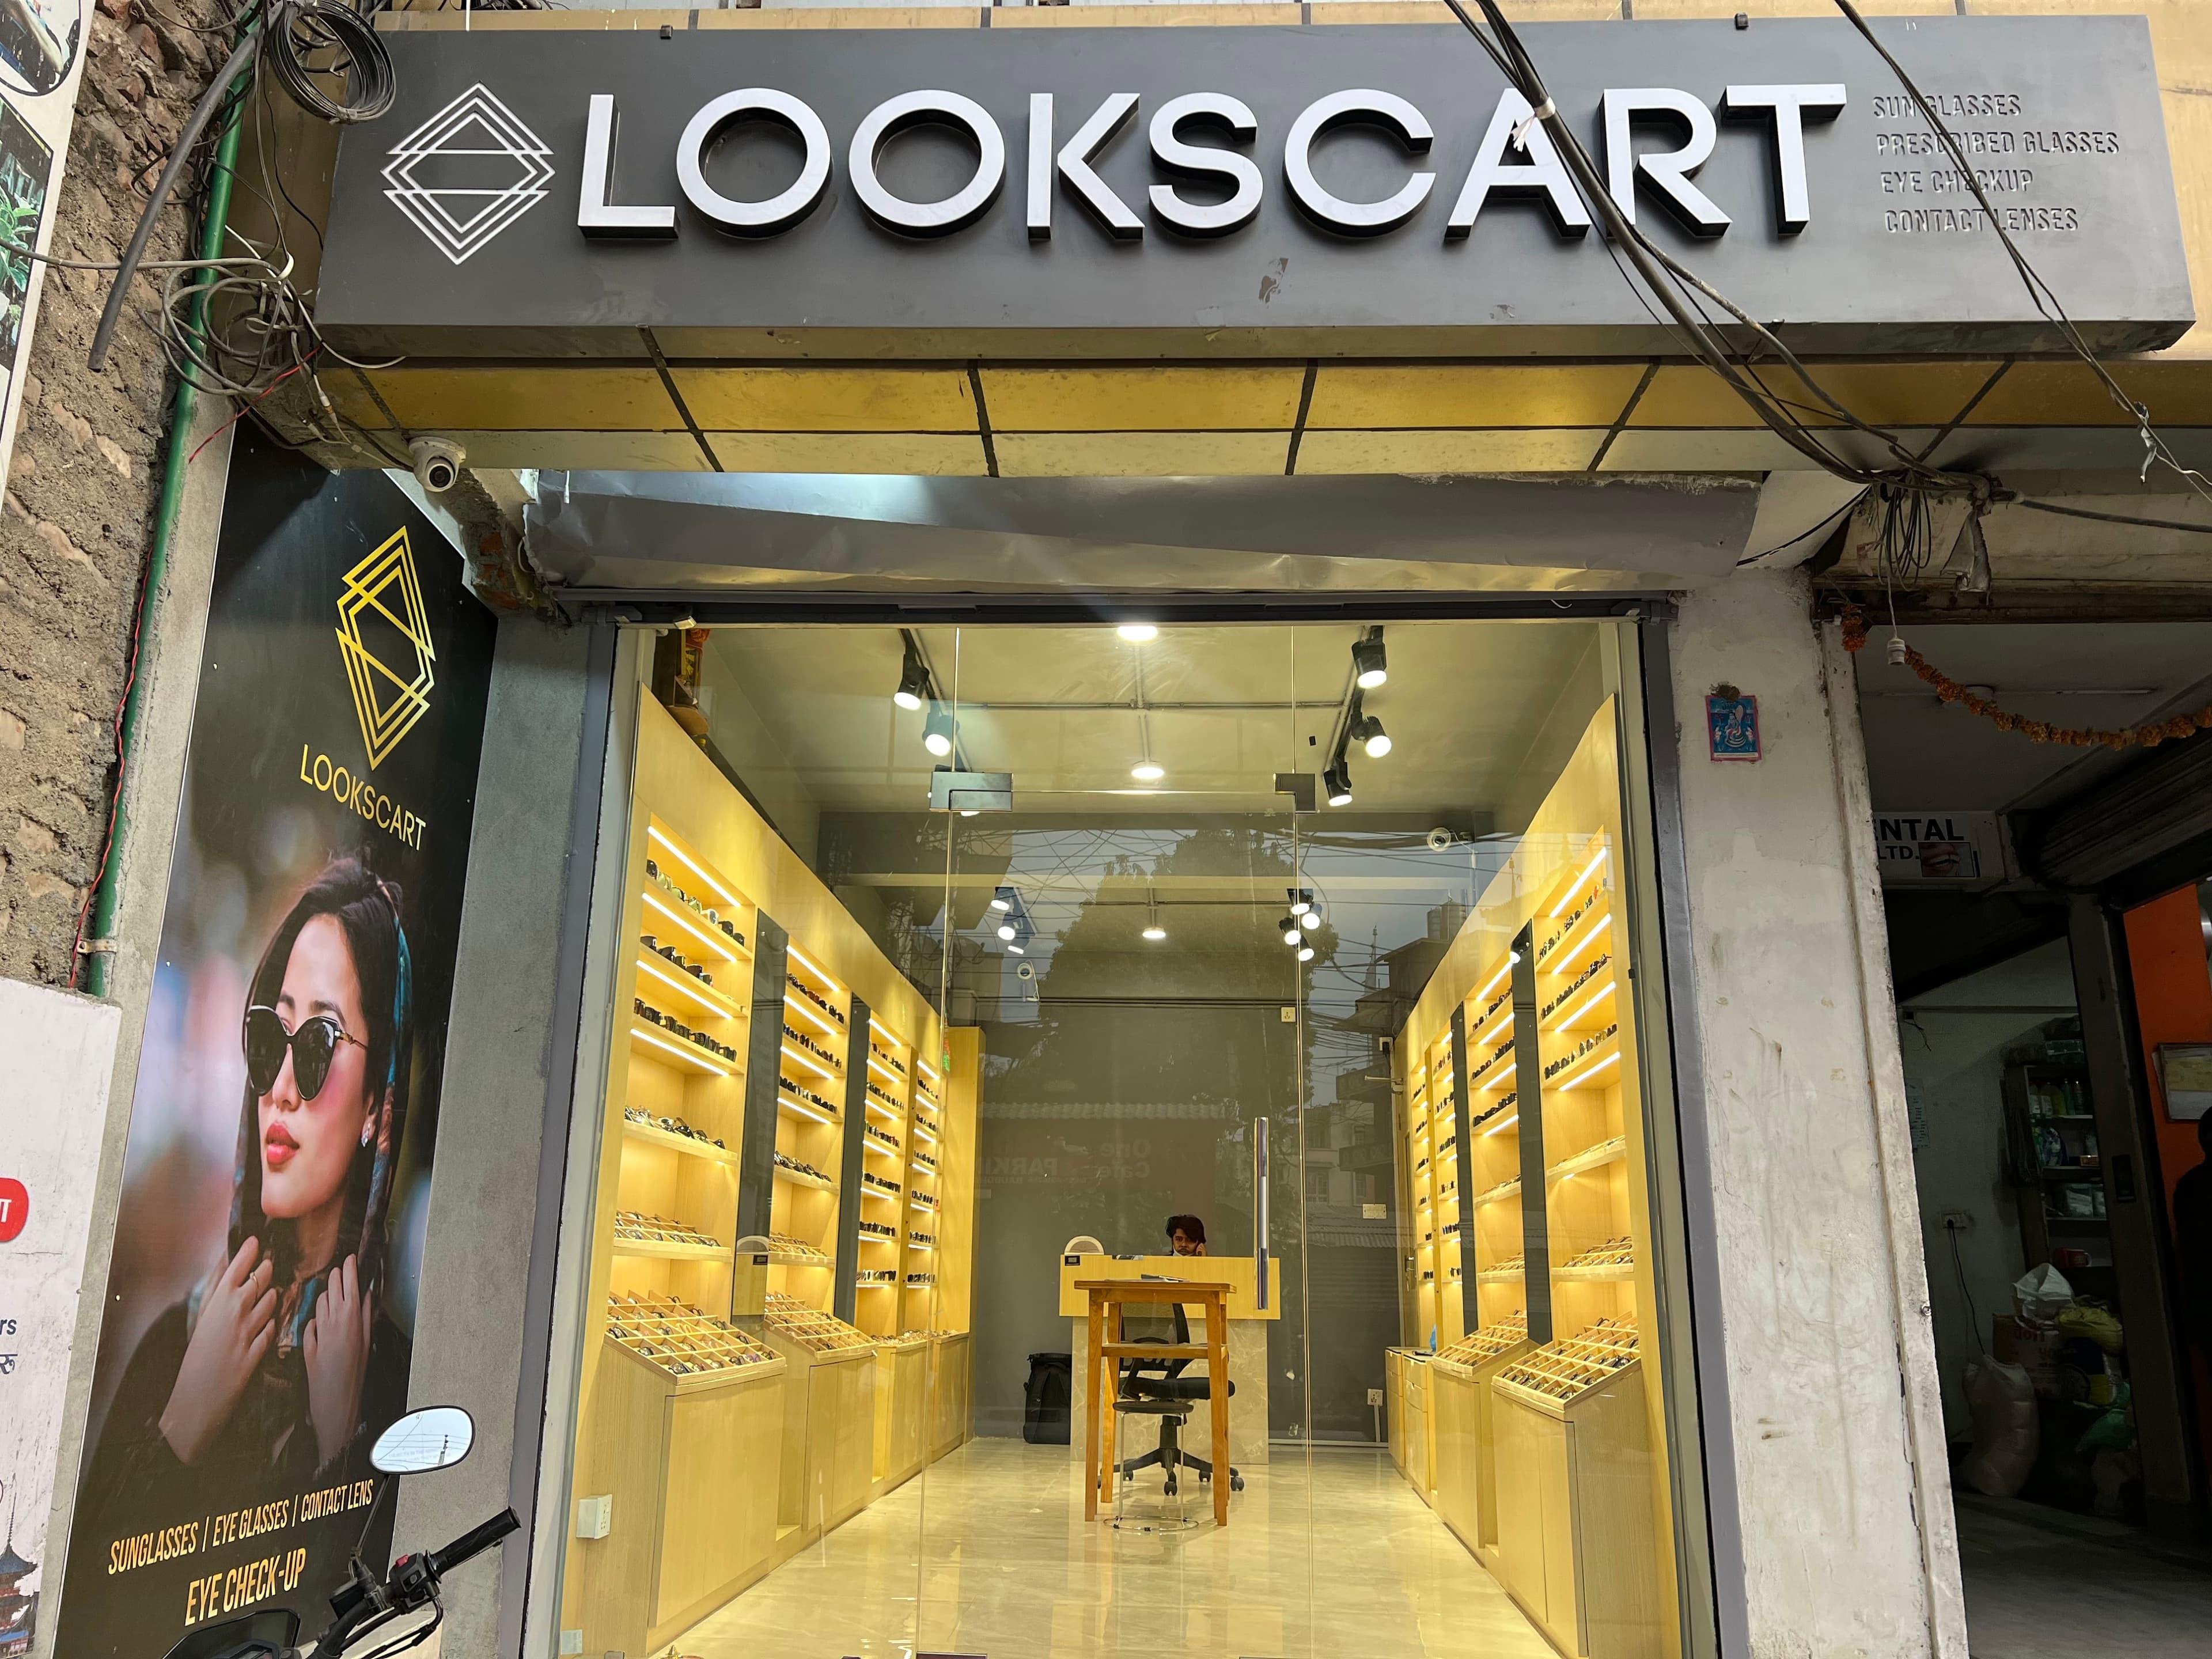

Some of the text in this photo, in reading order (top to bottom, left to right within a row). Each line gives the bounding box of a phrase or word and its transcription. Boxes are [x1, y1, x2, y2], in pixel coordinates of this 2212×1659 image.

[578, 84, 1847, 240] LOOKSCART
[1881, 171, 1923, 194] EYE
[2023, 131, 2119, 154] GLASSES
[1884, 209, 1986, 233] CONTACT
[300, 744, 426, 851] LOOKSCART
[108, 1521, 199, 1575] SUNGLASSES
[212, 1512, 238, 1547] EYE
[238, 1499, 290, 1540] GLASSES
[300, 1485, 347, 1522] CONTACT
[347, 1479, 374, 1510] LENS
[184, 1547, 306, 1627] EYE CHECK-UP
